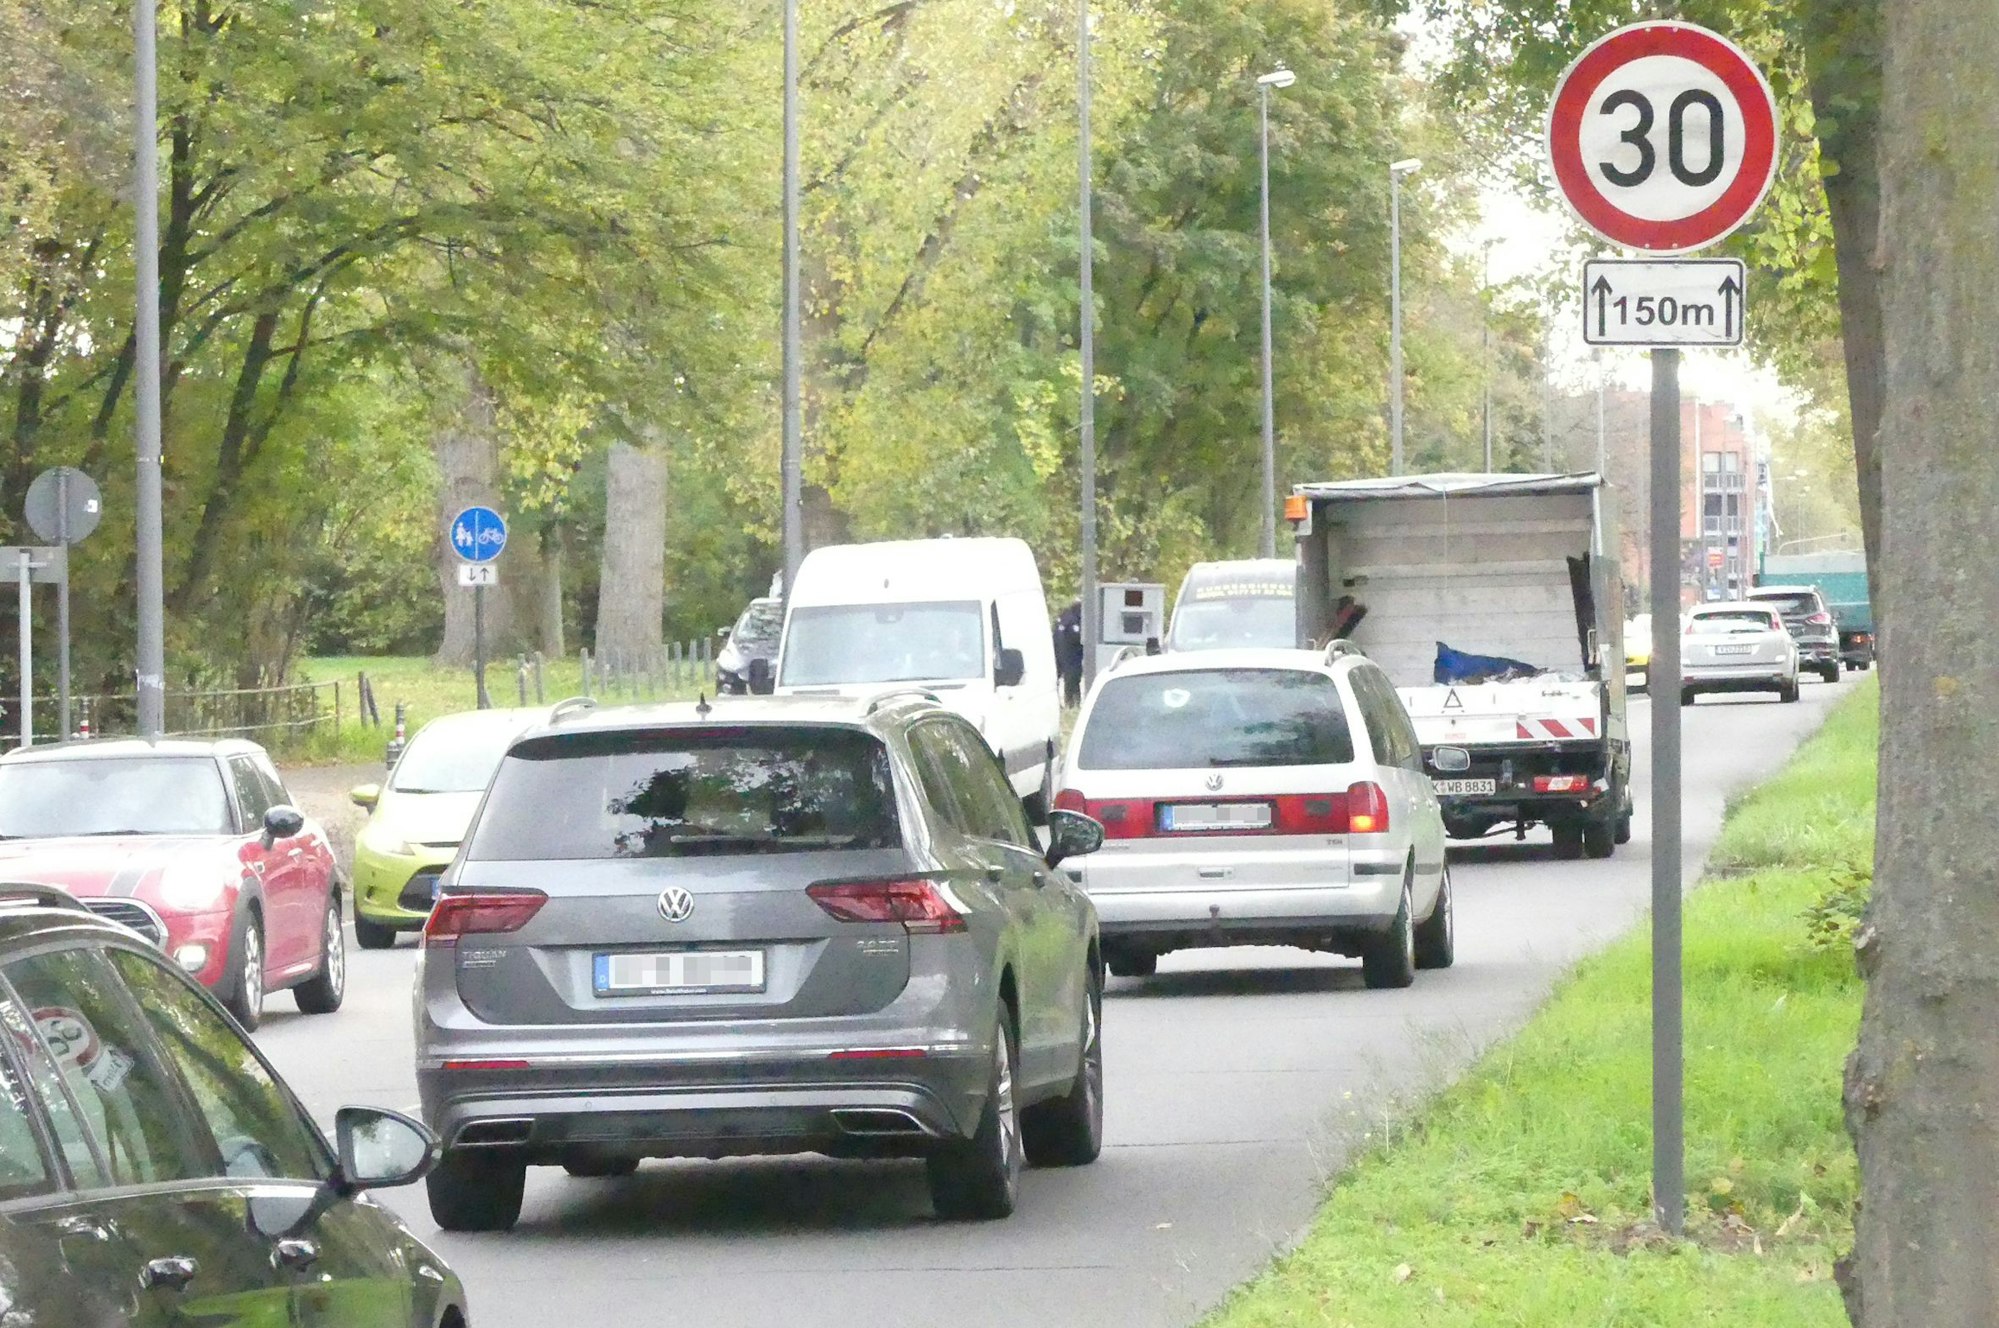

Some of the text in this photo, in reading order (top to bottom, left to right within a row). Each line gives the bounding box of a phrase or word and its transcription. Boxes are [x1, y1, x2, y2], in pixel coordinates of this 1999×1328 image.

[1598, 88, 1725, 188] 30
[1613, 295, 1715, 327] 150m
[1447, 781, 1463, 793] WB
[1465, 781, 1494, 792] 8831
